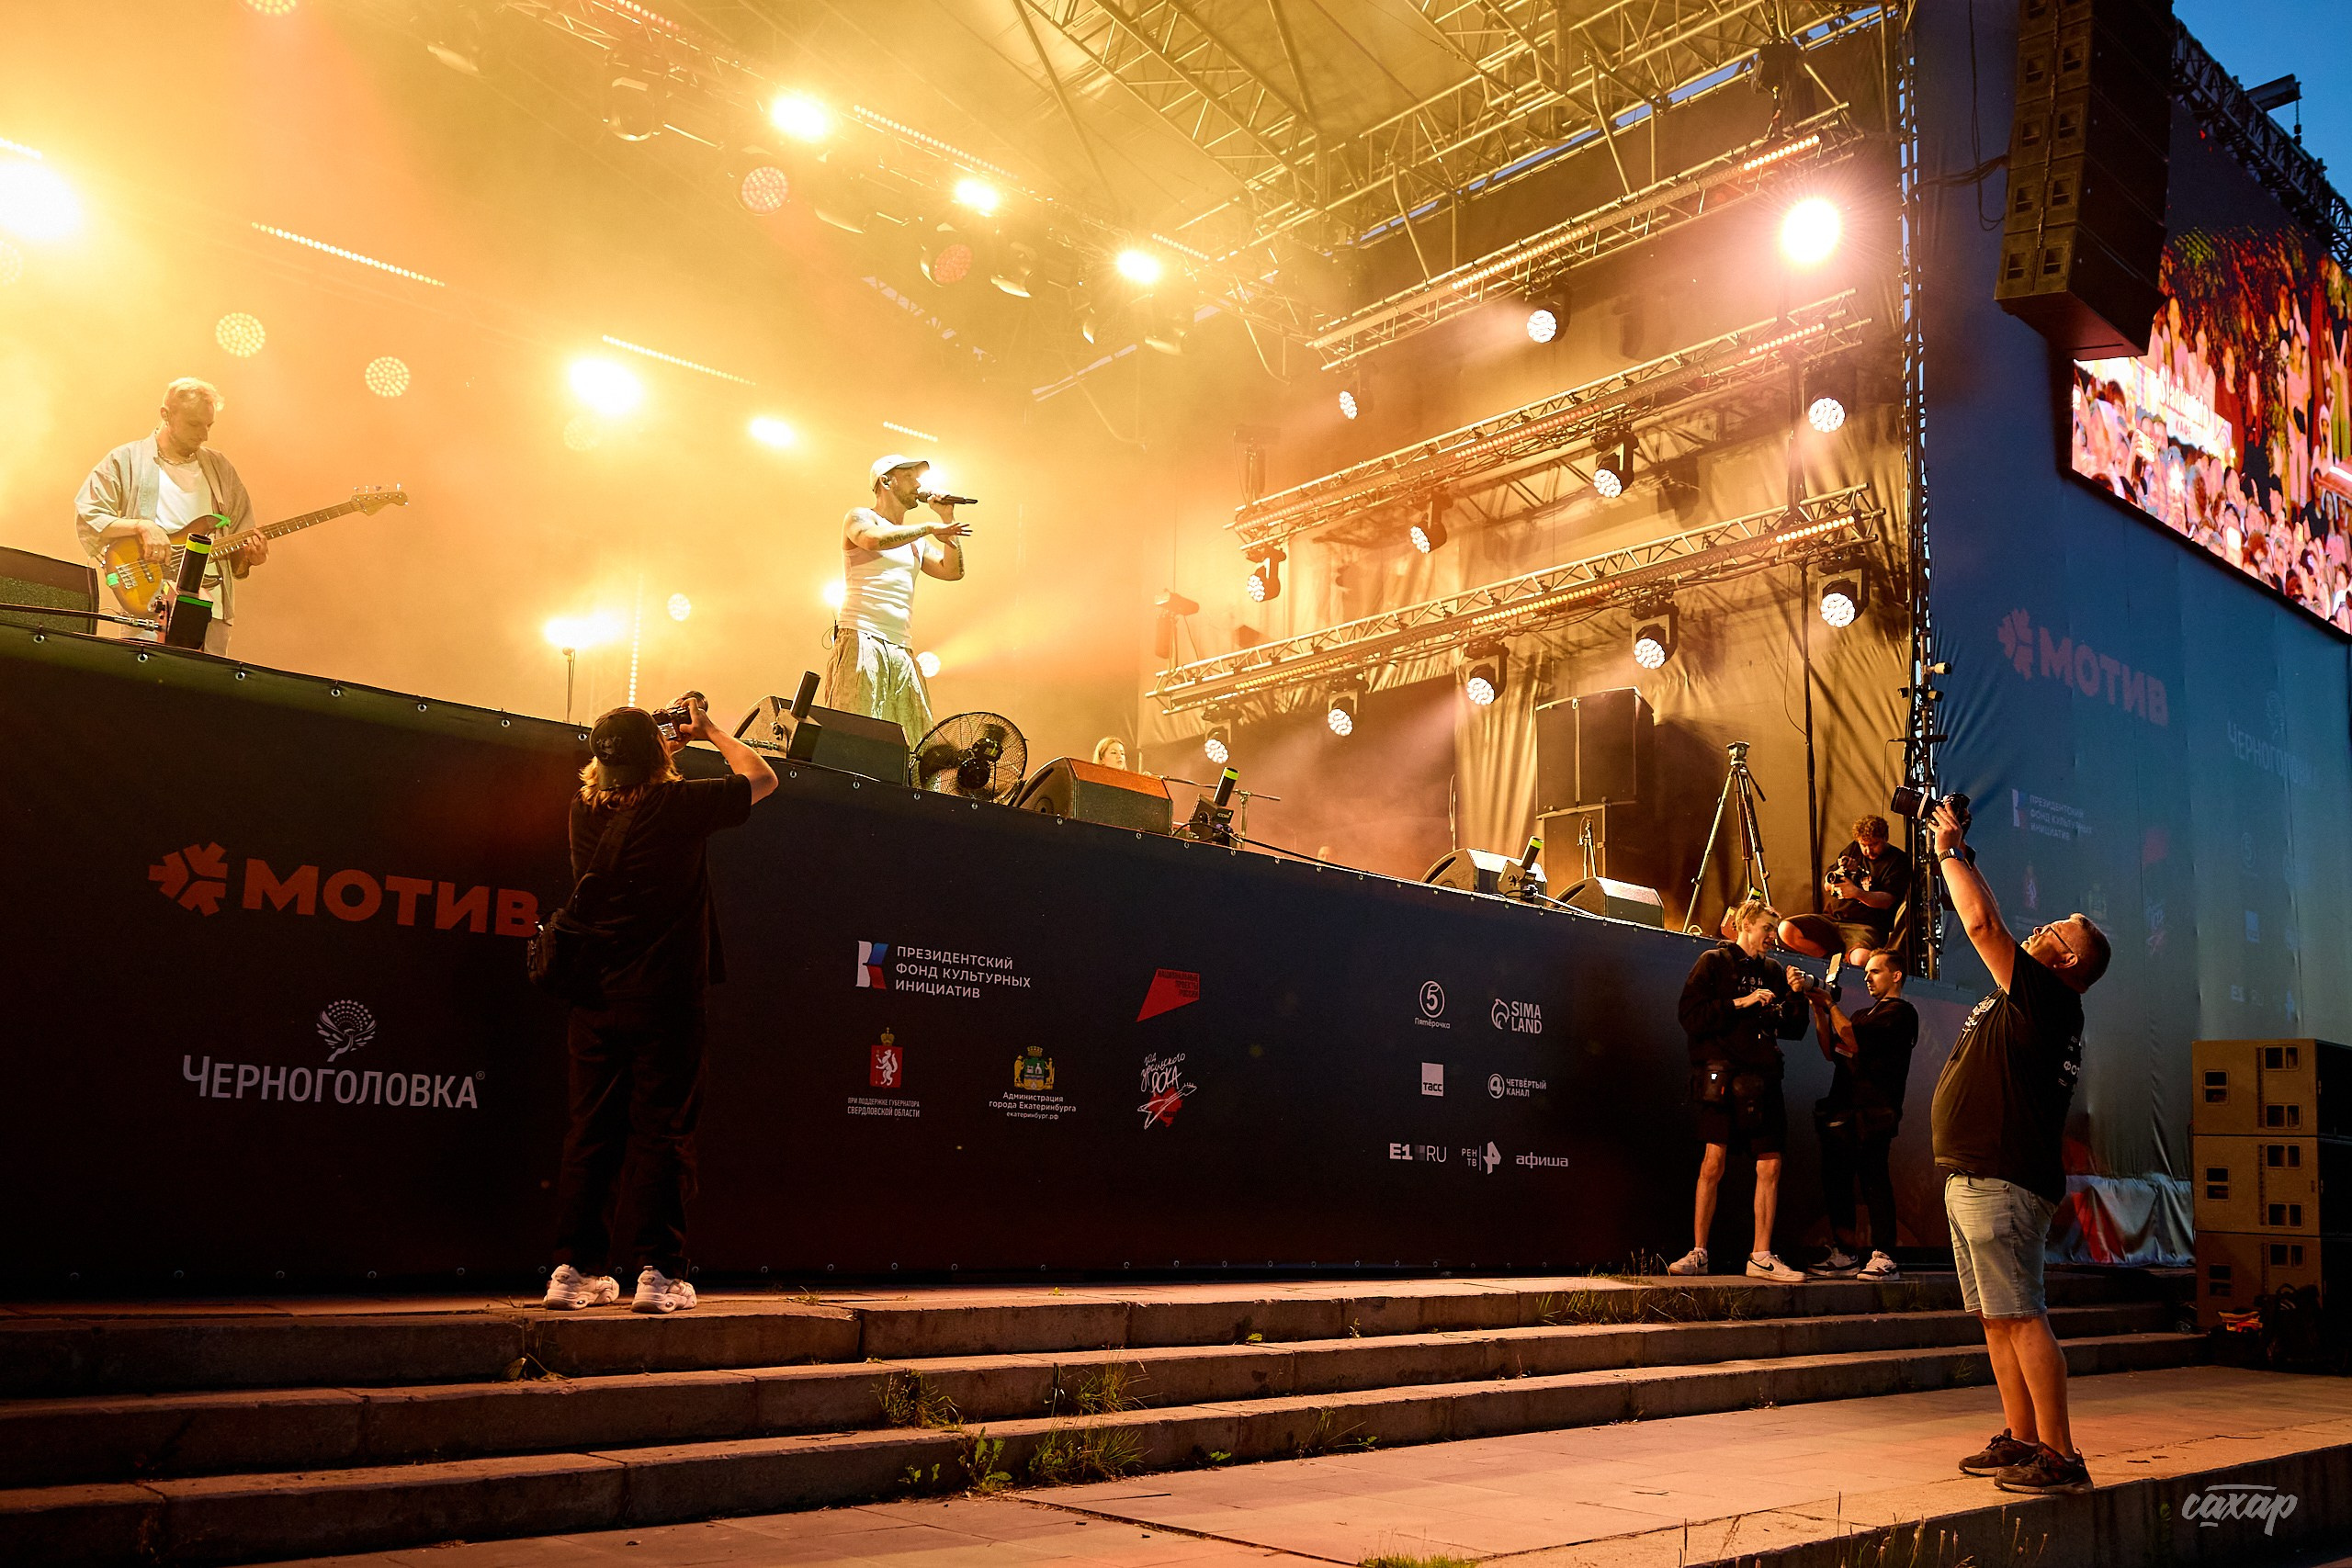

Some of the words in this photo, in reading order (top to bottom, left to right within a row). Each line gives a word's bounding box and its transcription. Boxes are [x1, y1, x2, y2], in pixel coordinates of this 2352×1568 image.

[2039, 626, 2169, 727] МОТИВ
[243, 857, 539, 938] МОТИВ
[897, 945, 1013, 970] ПРЕЗИДЕНТСКИЙ
[895, 962, 938, 979] ФОНД
[943, 969, 1032, 988] КУЛЬТУРНЫХ
[895, 979, 981, 998] ИНИЦИАТИВ
[1426, 984, 1440, 1011] 5
[1511, 1000, 1542, 1020] SIMA
[1414, 1017, 1451, 1030] Пятёрочка
[1511, 1018, 1543, 1034] LAND
[1506, 1077, 1547, 1090] ЧЕТВЁРТЫЙ
[1002, 1091, 1064, 1102] Администрация
[1506, 1087, 1530, 1098] КАНАЛ
[858, 1098, 888, 1106] ПОДДЕРЖКЕ
[888, 1099, 920, 1108] ГУБЕРНАТОРА
[989, 1100, 1017, 1109] города
[1019, 1101, 1077, 1112] Екатеринбурга
[847, 1106, 893, 1116] СВЕРДЛОВСКОЙ
[894, 1108, 921, 1117] ОБЛАСТИ
[1006, 1111, 1059, 1120] екатеринбург.рф
[1389, 1142, 1413, 1160] E1
[1426, 1145, 1447, 1163] RU
[1461, 1148, 1477, 1157] РЕН
[1467, 1157, 1477, 1167] ТВ
[1515, 1151, 1569, 1169] афиша
